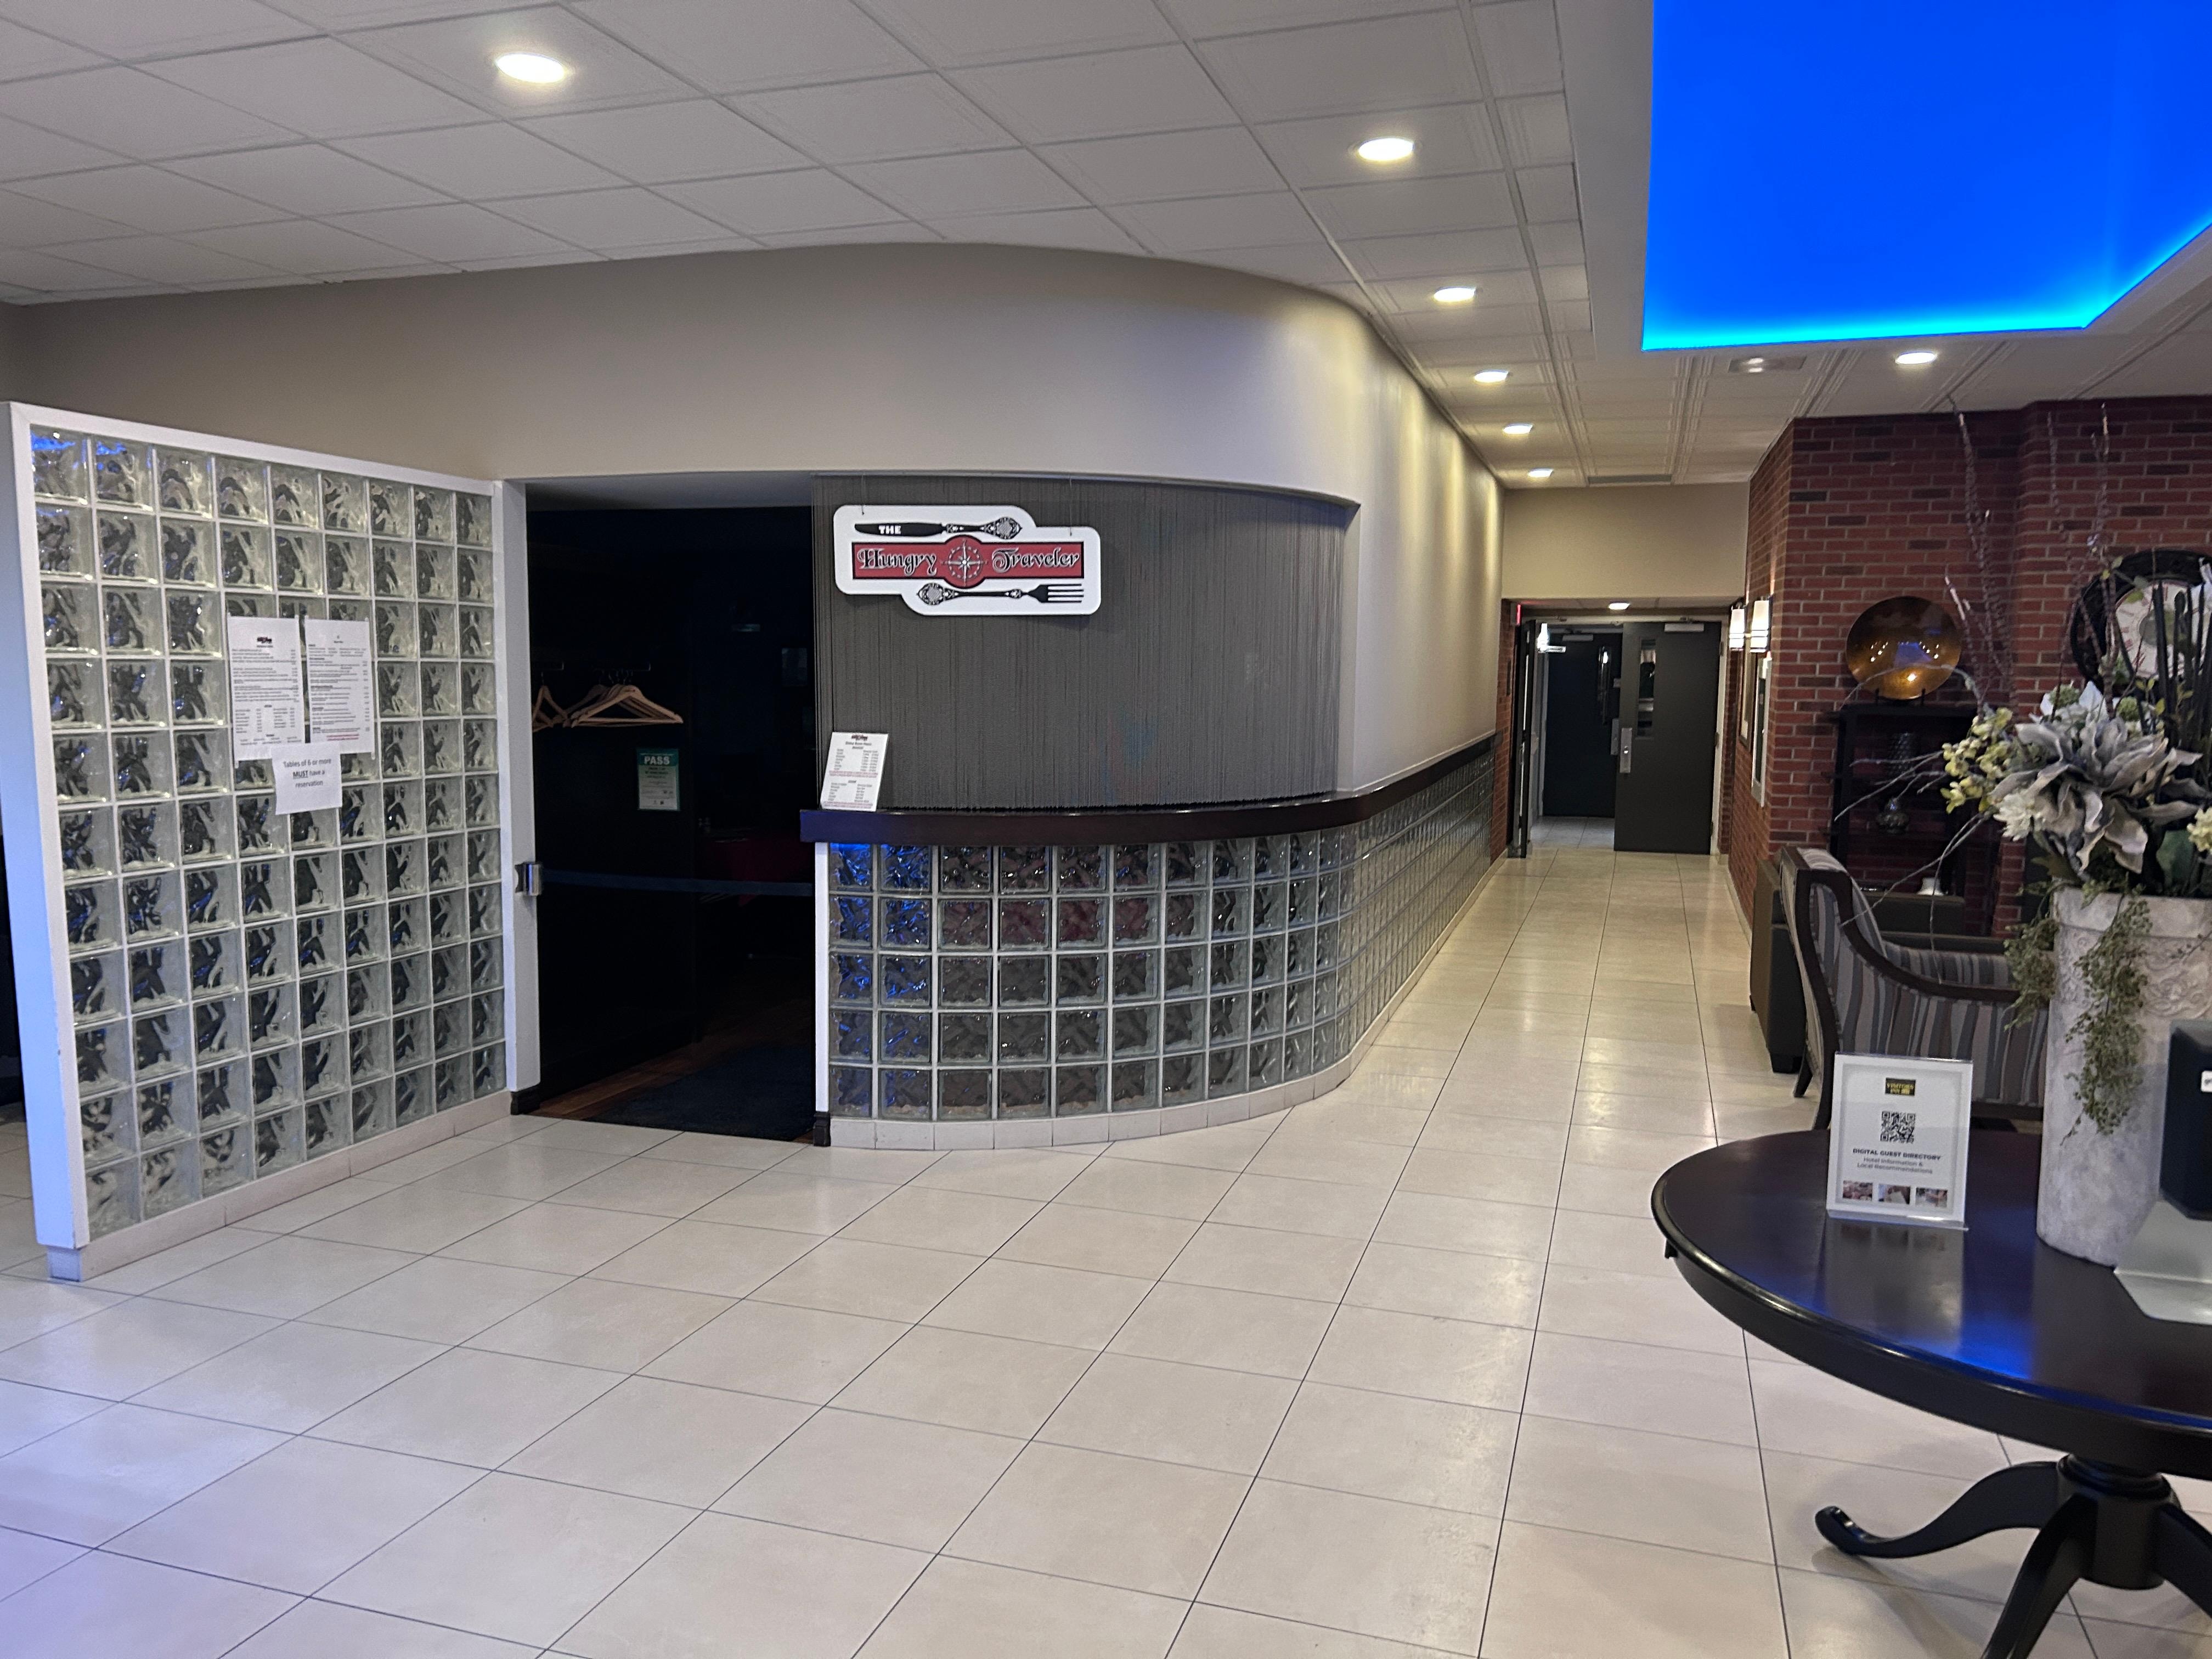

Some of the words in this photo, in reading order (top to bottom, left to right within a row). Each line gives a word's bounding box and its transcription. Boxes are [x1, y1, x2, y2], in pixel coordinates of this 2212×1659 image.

[878, 525, 902, 535] THE
[857, 548, 938, 576] Hungry
[991, 547, 1080, 573] Traveler
[644, 755, 670, 765] PASS
[1903, 1152, 1941, 1160] DIRECTORY
[1881, 1158, 1917, 1166] Information
[1874, 1163, 1933, 1174] Recommendations
